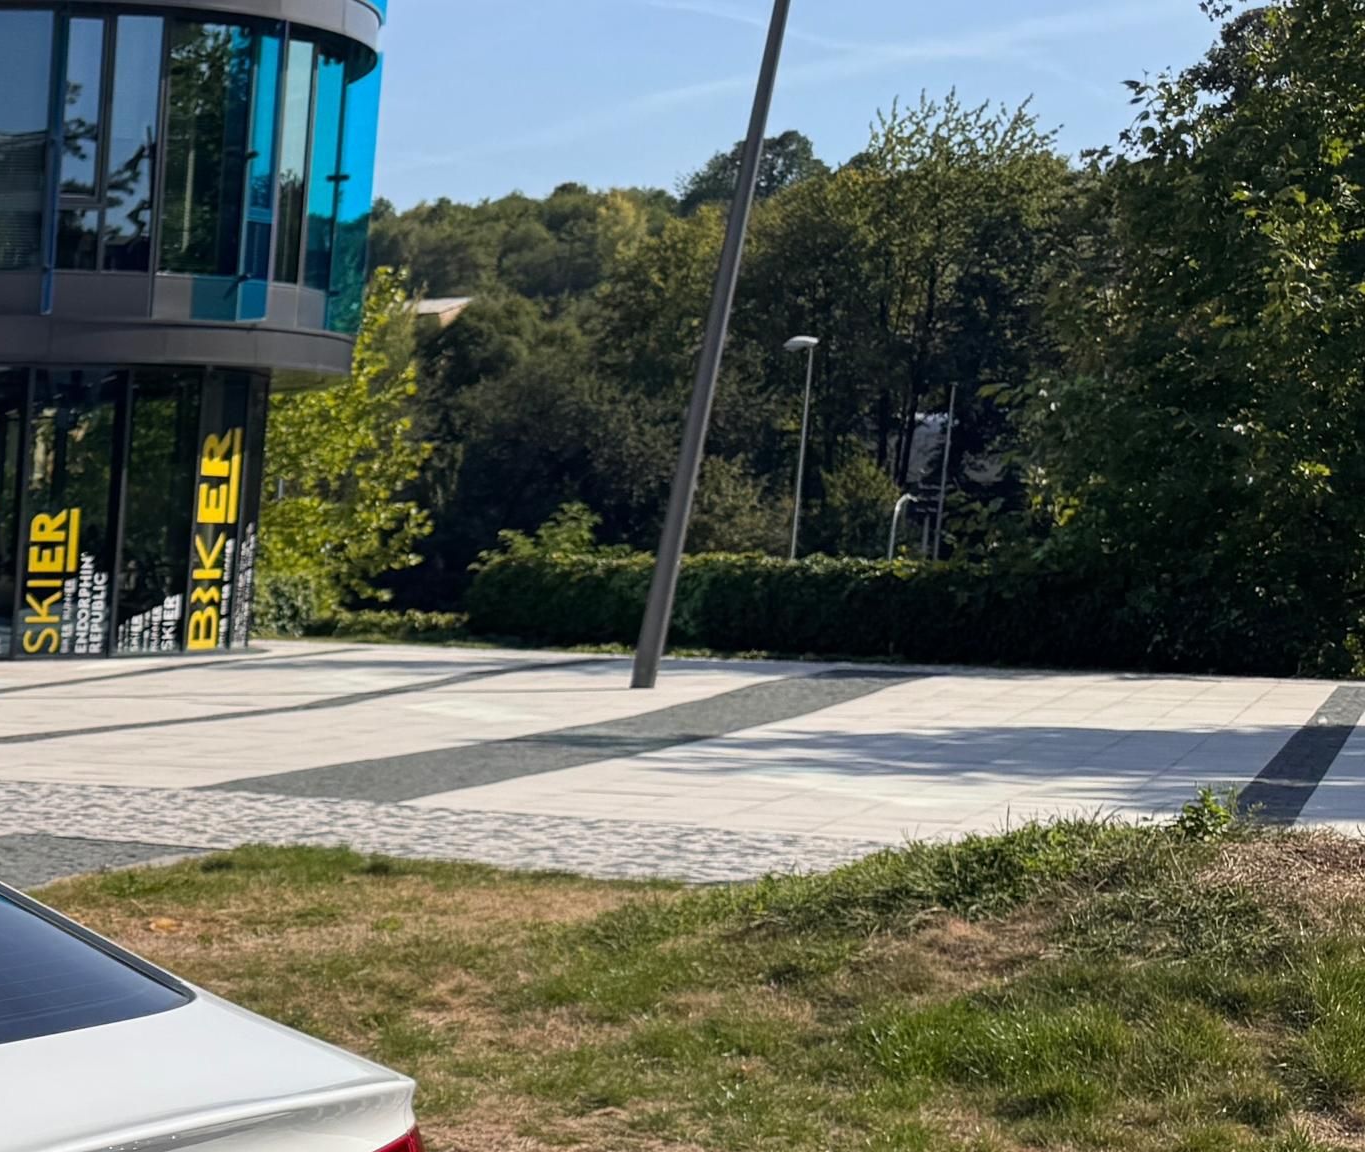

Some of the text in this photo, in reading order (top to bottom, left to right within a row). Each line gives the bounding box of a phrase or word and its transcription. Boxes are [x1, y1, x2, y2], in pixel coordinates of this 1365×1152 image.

[22, 507, 72, 655] SKIER
[88, 571, 108, 654] REPUBLIC
[160, 594, 177, 652] SKIER
